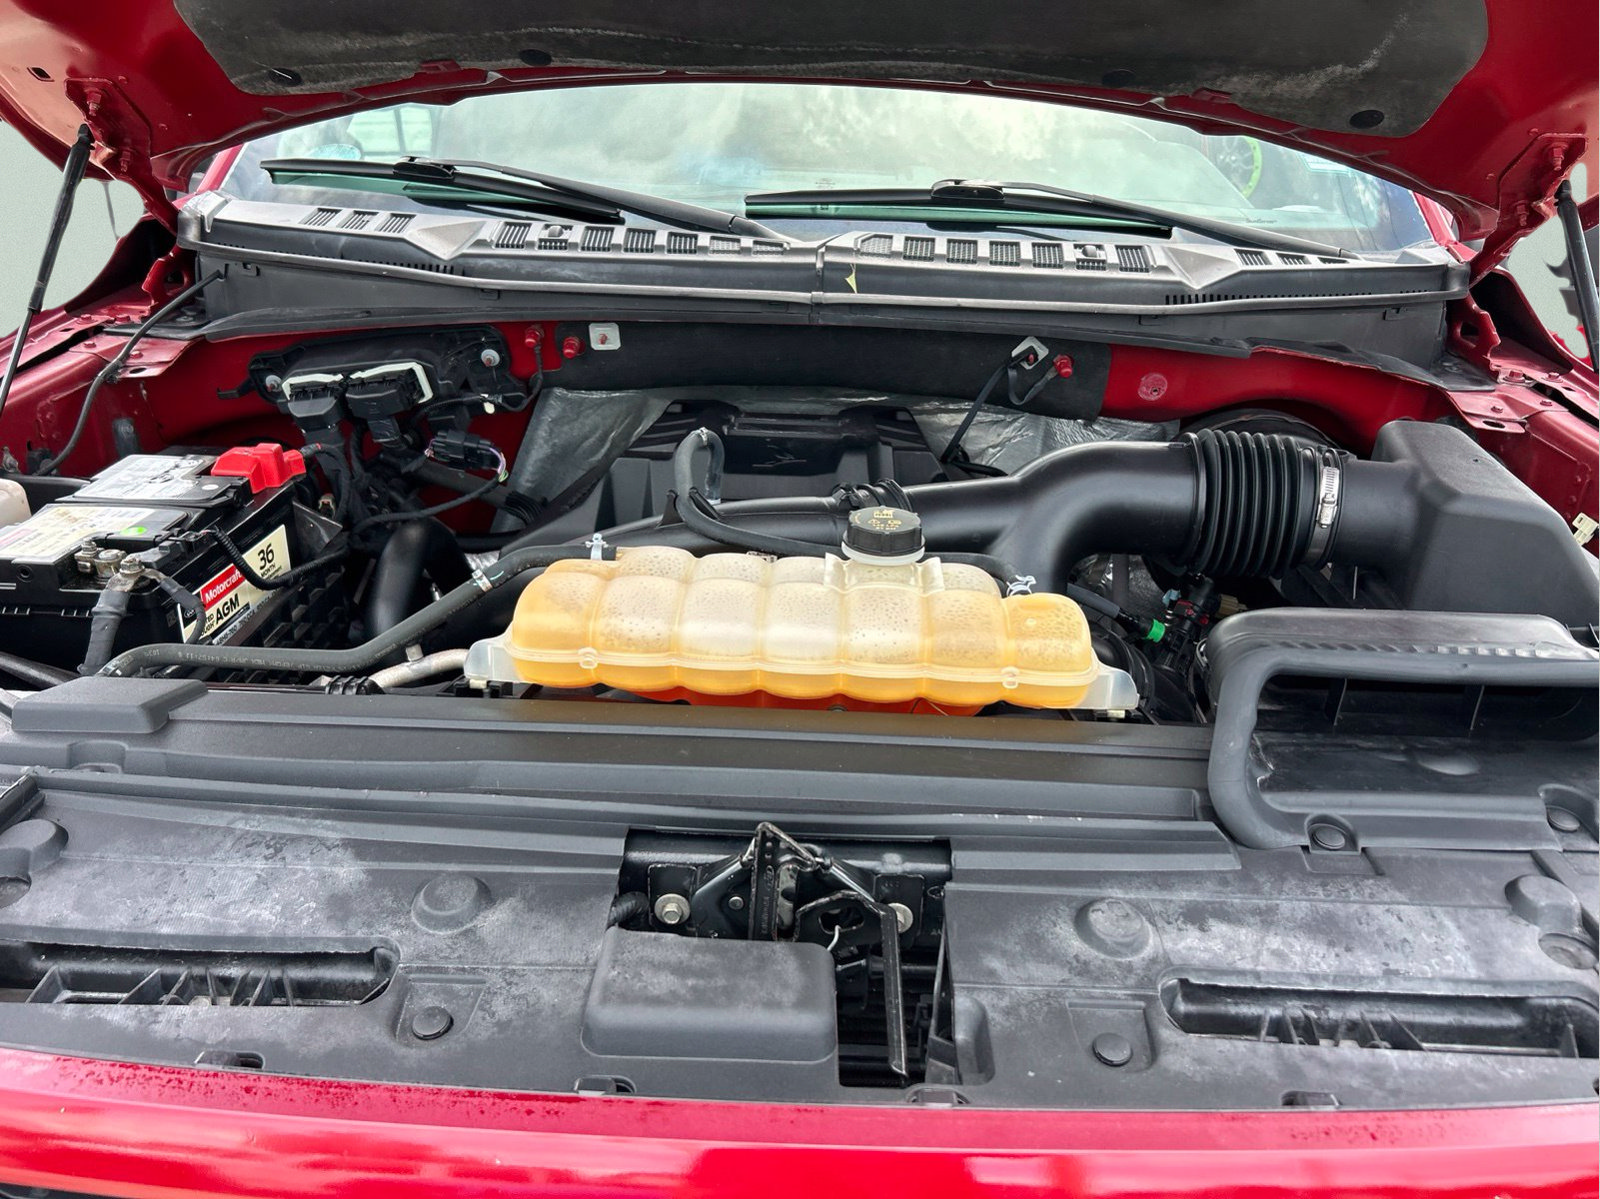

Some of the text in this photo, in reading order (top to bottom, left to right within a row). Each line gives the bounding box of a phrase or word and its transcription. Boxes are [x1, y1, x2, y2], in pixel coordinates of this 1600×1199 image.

[257, 543, 275, 570] 36
[261, 562, 276, 577] MONTH
[206, 613, 214, 623] TED
[215, 593, 240, 624] AGM
[202, 621, 214, 636] OUGH
